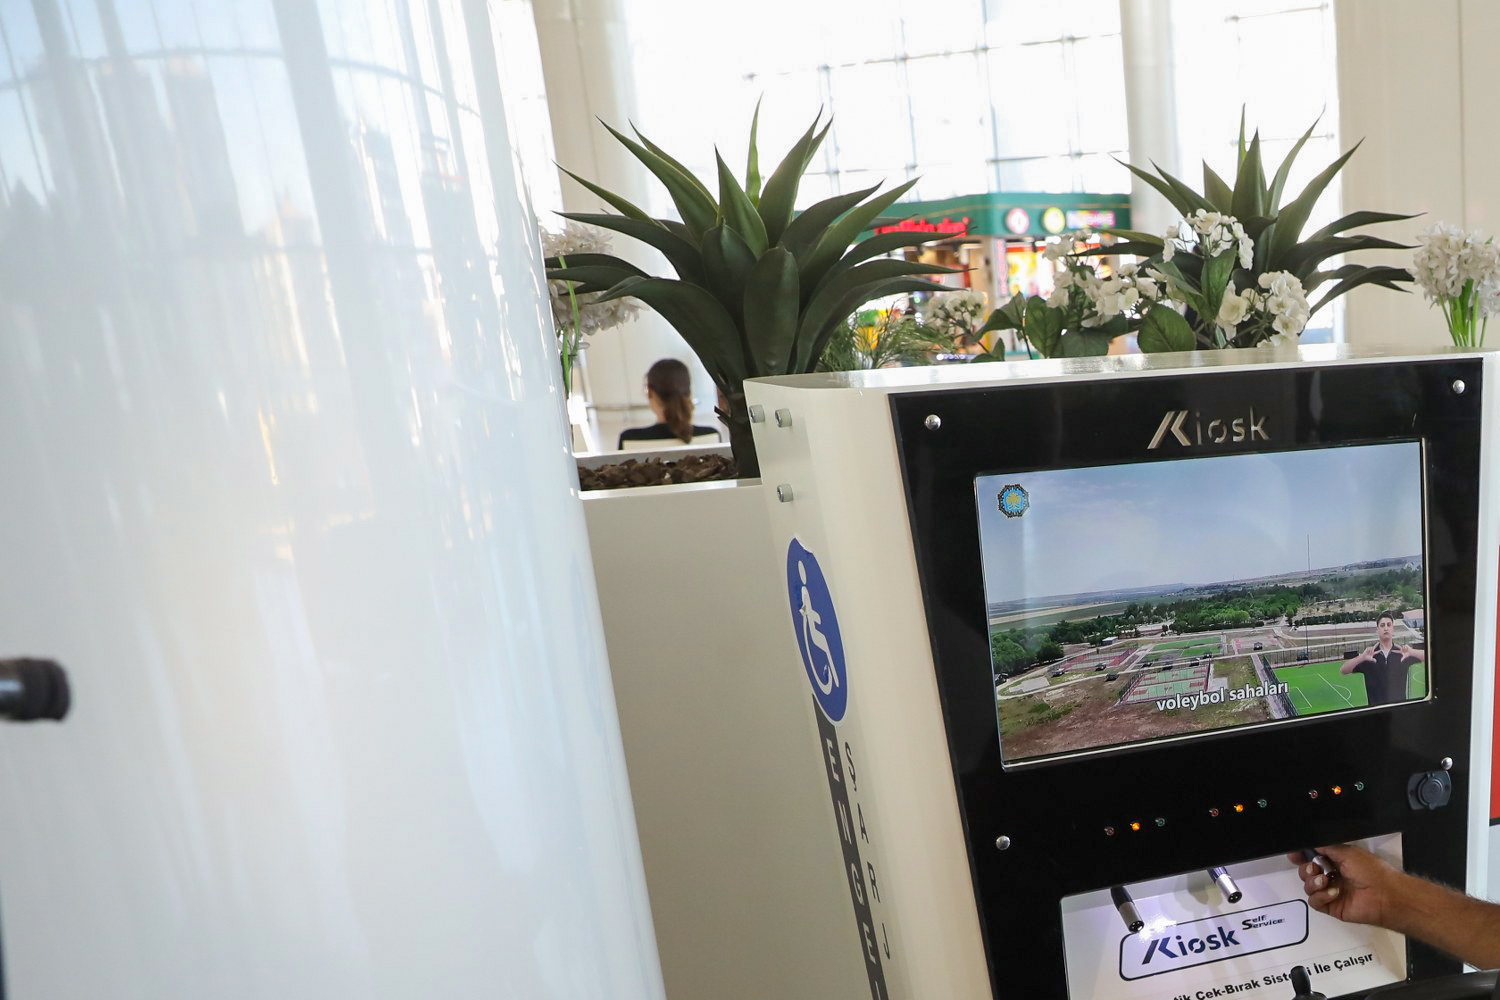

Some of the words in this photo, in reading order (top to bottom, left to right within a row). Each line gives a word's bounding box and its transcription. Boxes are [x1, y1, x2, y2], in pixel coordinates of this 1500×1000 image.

[1147, 406, 1272, 451] Kiosk
[1156, 687, 1225, 712] voleybol
[1229, 681, 1289, 701] sahaları
[844, 741, 891, 960] ŞARJ
[1141, 926, 1241, 965] Kiosk
[1263, 966, 1312, 986] Sisti
[1313, 963, 1331, 974] İle
[1334, 954, 1373, 971] Çalışır
